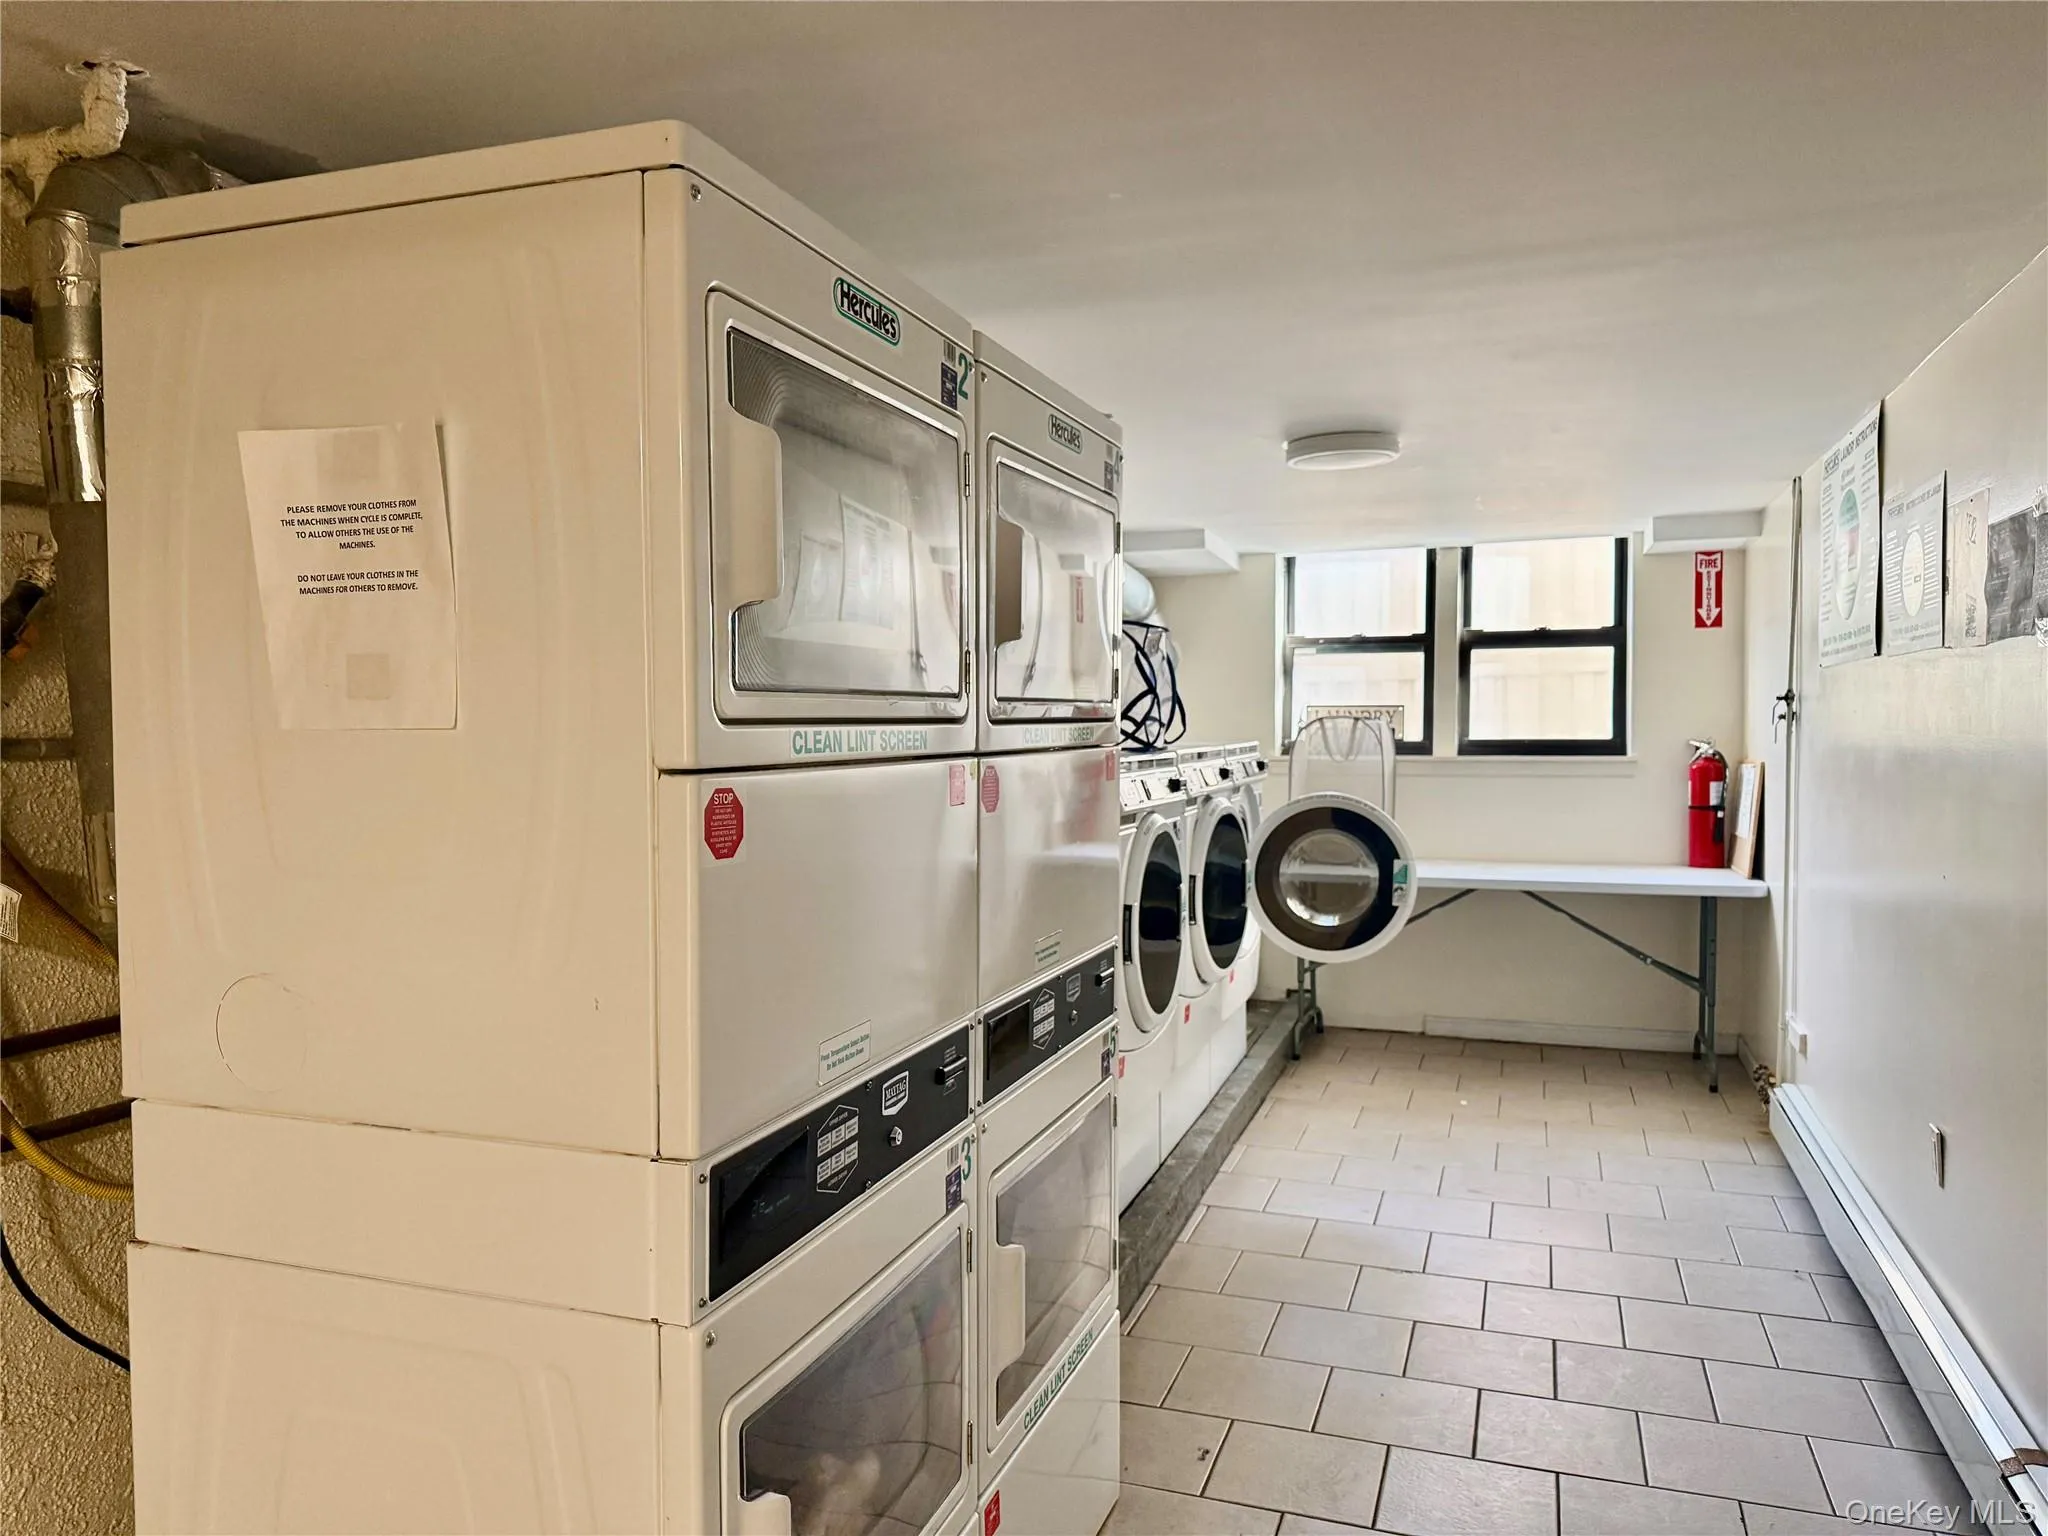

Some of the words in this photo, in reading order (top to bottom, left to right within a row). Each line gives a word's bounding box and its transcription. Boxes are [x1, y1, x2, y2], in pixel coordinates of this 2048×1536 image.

[840, 279, 897, 339] Hercules
[958, 352, 968, 400] 2
[286, 505, 315, 514] PLEASE
[316, 504, 346, 513] REMOVE
[347, 502, 367, 511] YOUR
[368, 501, 397, 510] CLOTHES
[398, 499, 417, 508] FROM
[280, 519, 295, 527] THE
[297, 517, 337, 526] MACHINES
[337, 516, 359, 524] WHEN
[361, 514, 380, 523] CYCLE
[388, 511, 423, 521] COMPLETE,
[296, 531, 306, 539] TO
[308, 530, 335, 538] ALLOW
[335, 528, 361, 537] OTHERS
[362, 527, 375, 536] THE
[376, 526, 390, 535] USE
[390, 526, 400, 534] OF
[401, 525, 414, 533] THE
[339, 540, 376, 550] MACHINES.
[1699, 558, 1719, 569] FIRE
[297, 574, 309, 583] DO
[310, 574, 326, 582] NOT
[327, 573, 345, 581] LEAVE
[346, 572, 365, 580] YOUR
[366, 570, 396, 579] CLOTHES
[396, 570, 404, 578] IN
[406, 569, 419, 578] THE
[299, 586, 335, 595] MACHINES
[335, 585, 348, 594] FOR
[349, 584, 376, 593] OTHERS
[377, 583, 386, 592] TO
[387, 582, 419, 591] REMOVE.
[792, 729, 842, 755] CLEAN
[847, 729, 876, 752] LINT
[880, 729, 928, 751] SCREEN
[1068, 726, 1094, 742] SCREEN
[713, 793, 734, 805] STOP
[885, 1079, 907, 1101] MAYTAG
[961, 1135, 972, 1181] 3
[1023, 1385, 1049, 1430] CLEAN
[1050, 1363, 1066, 1396] LINT
[1067, 1327, 1094, 1372] SCREEN
